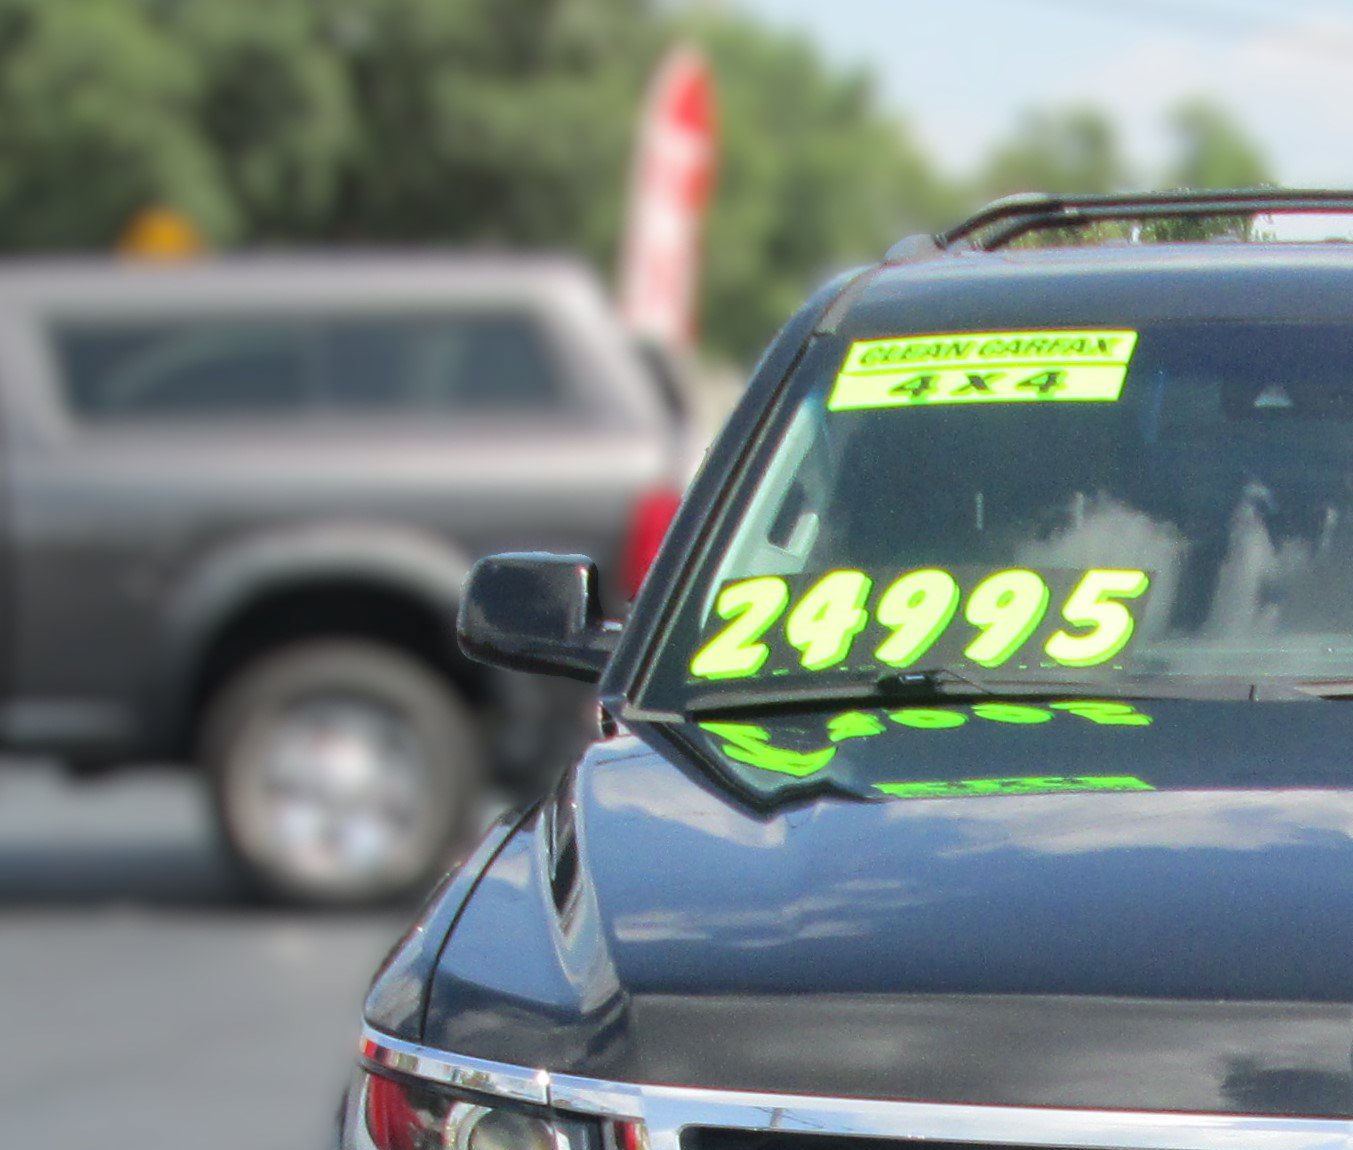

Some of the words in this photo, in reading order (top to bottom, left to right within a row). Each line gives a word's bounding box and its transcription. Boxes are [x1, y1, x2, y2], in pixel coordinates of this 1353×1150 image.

[860, 341, 974, 366] CLEAN
[977, 337, 1121, 357] CARFAX
[691, 568, 1150, 681] 24995
